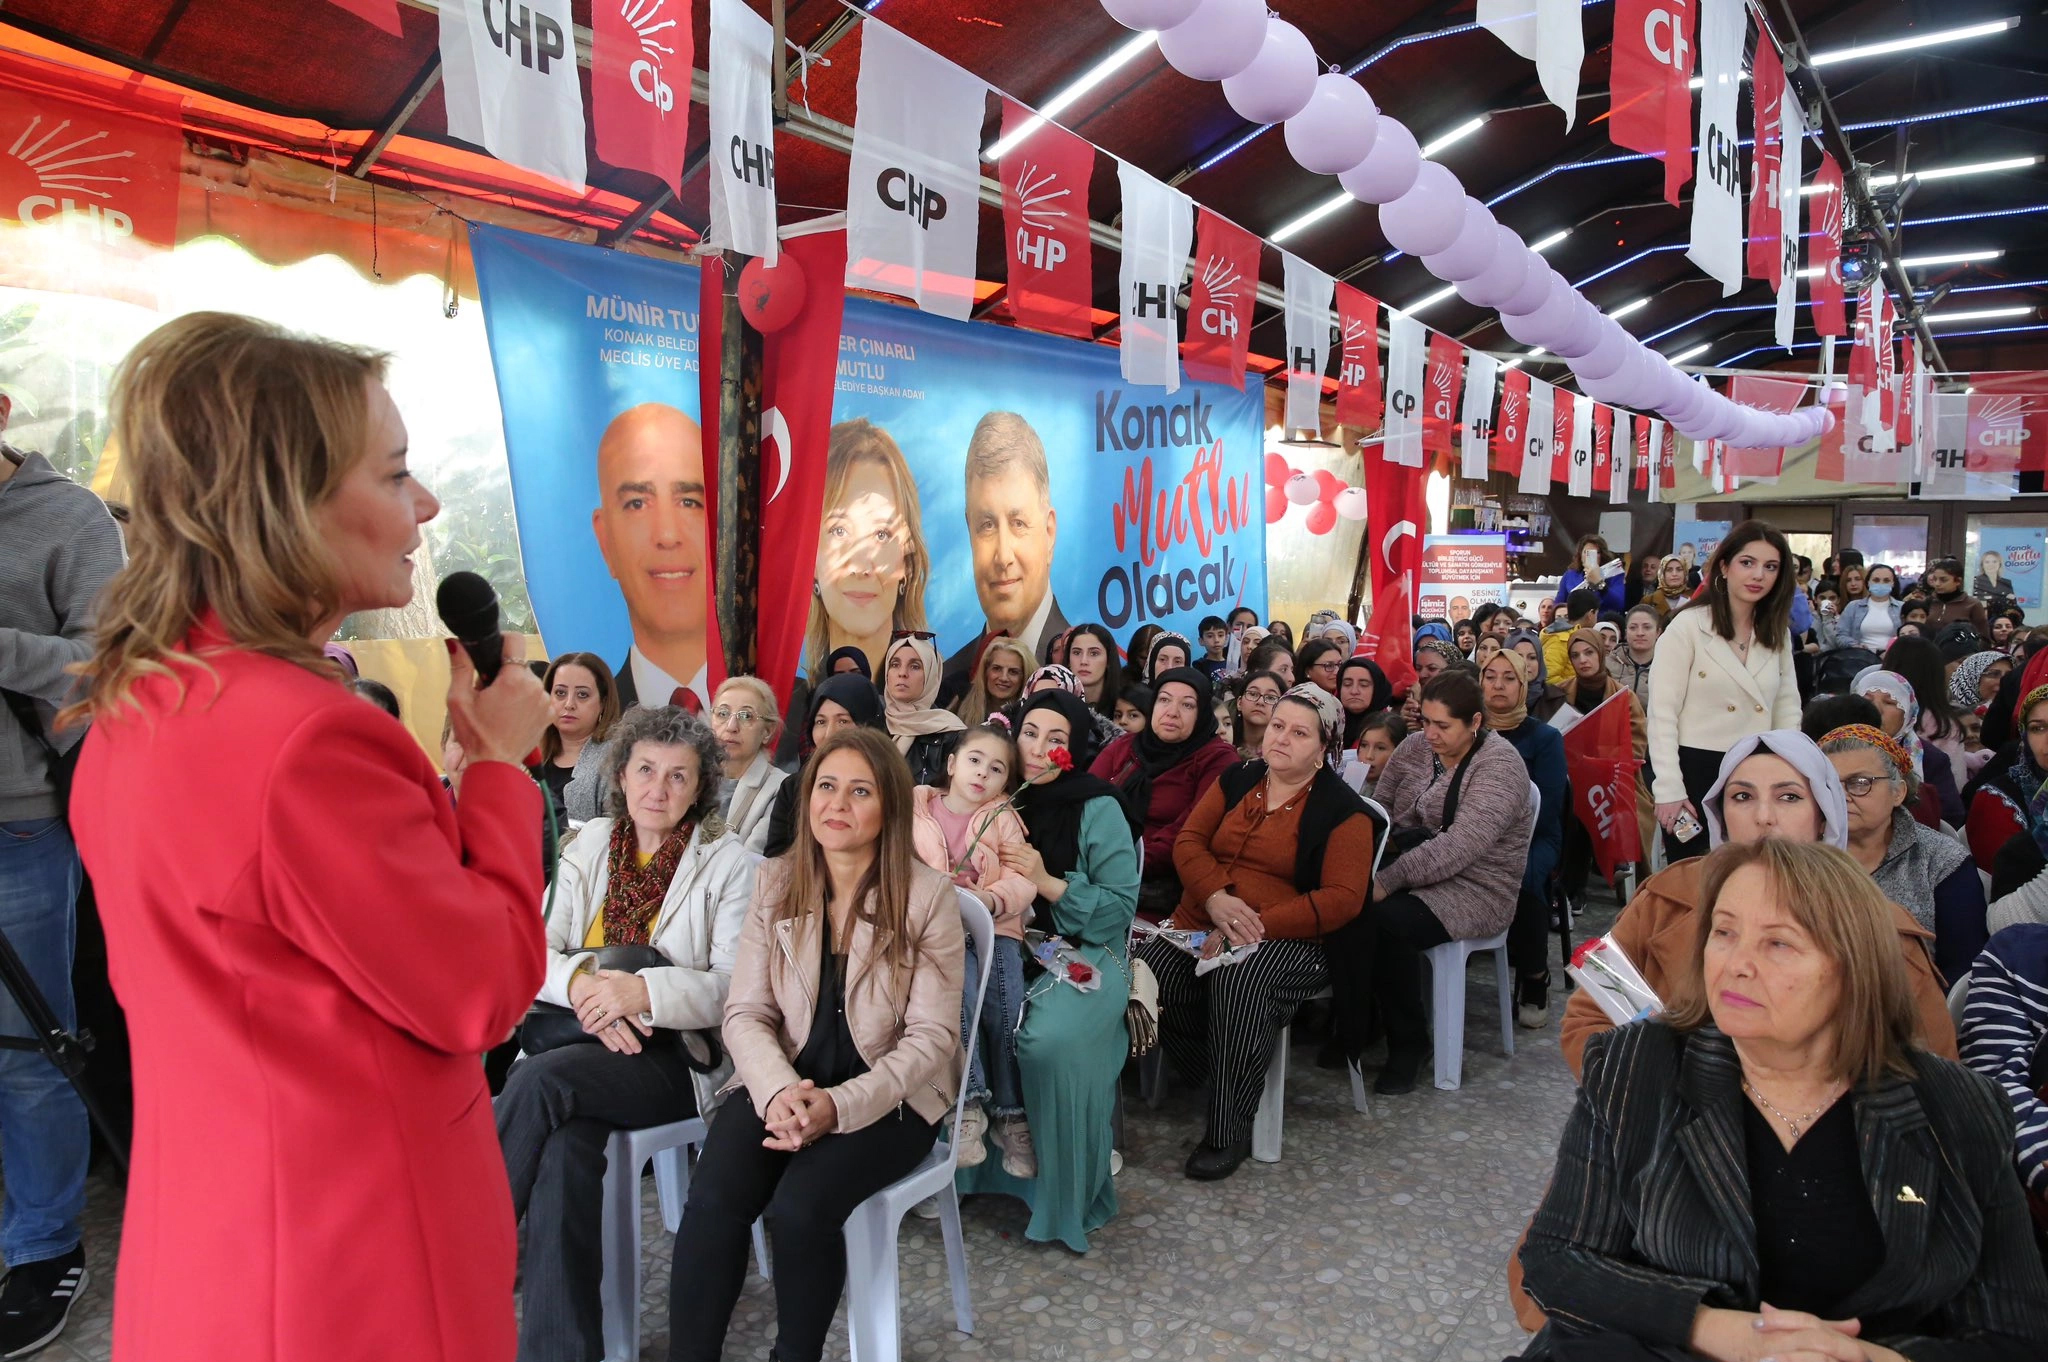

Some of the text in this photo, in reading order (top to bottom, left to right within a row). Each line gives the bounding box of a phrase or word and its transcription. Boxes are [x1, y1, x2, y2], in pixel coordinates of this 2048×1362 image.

[482, 0, 564, 75] CHP
[1644, 9, 1688, 71] CH
[876, 166, 948, 231] CHP
[17, 194, 134, 247] CHP
[1016, 226, 1067, 272] CHP
[586, 294, 664, 328] MÜNİR
[604, 327, 699, 353] KONAK BELEDİ
[859, 338, 916, 361] ÇINARLI
[600, 347, 699, 372] MECLİS ÜYE AD
[835, 359, 885, 381] MUTLU
[1340, 361, 1366, 387] HP
[867, 382, 901, 398] BAŞKAN
[902, 386, 925, 401] ADAYI
[1392, 389, 1416, 419] CP
[1095, 389, 1214, 453] Konak
[1529, 437, 1544, 458] CH
[1978, 428, 2032, 447] CHP
[1112, 438, 1250, 568] Mutlu
[2005, 544, 2032, 552] Konak
[2005, 560, 2036, 568] Olacak
[1097, 545, 1235, 630] Olacak
